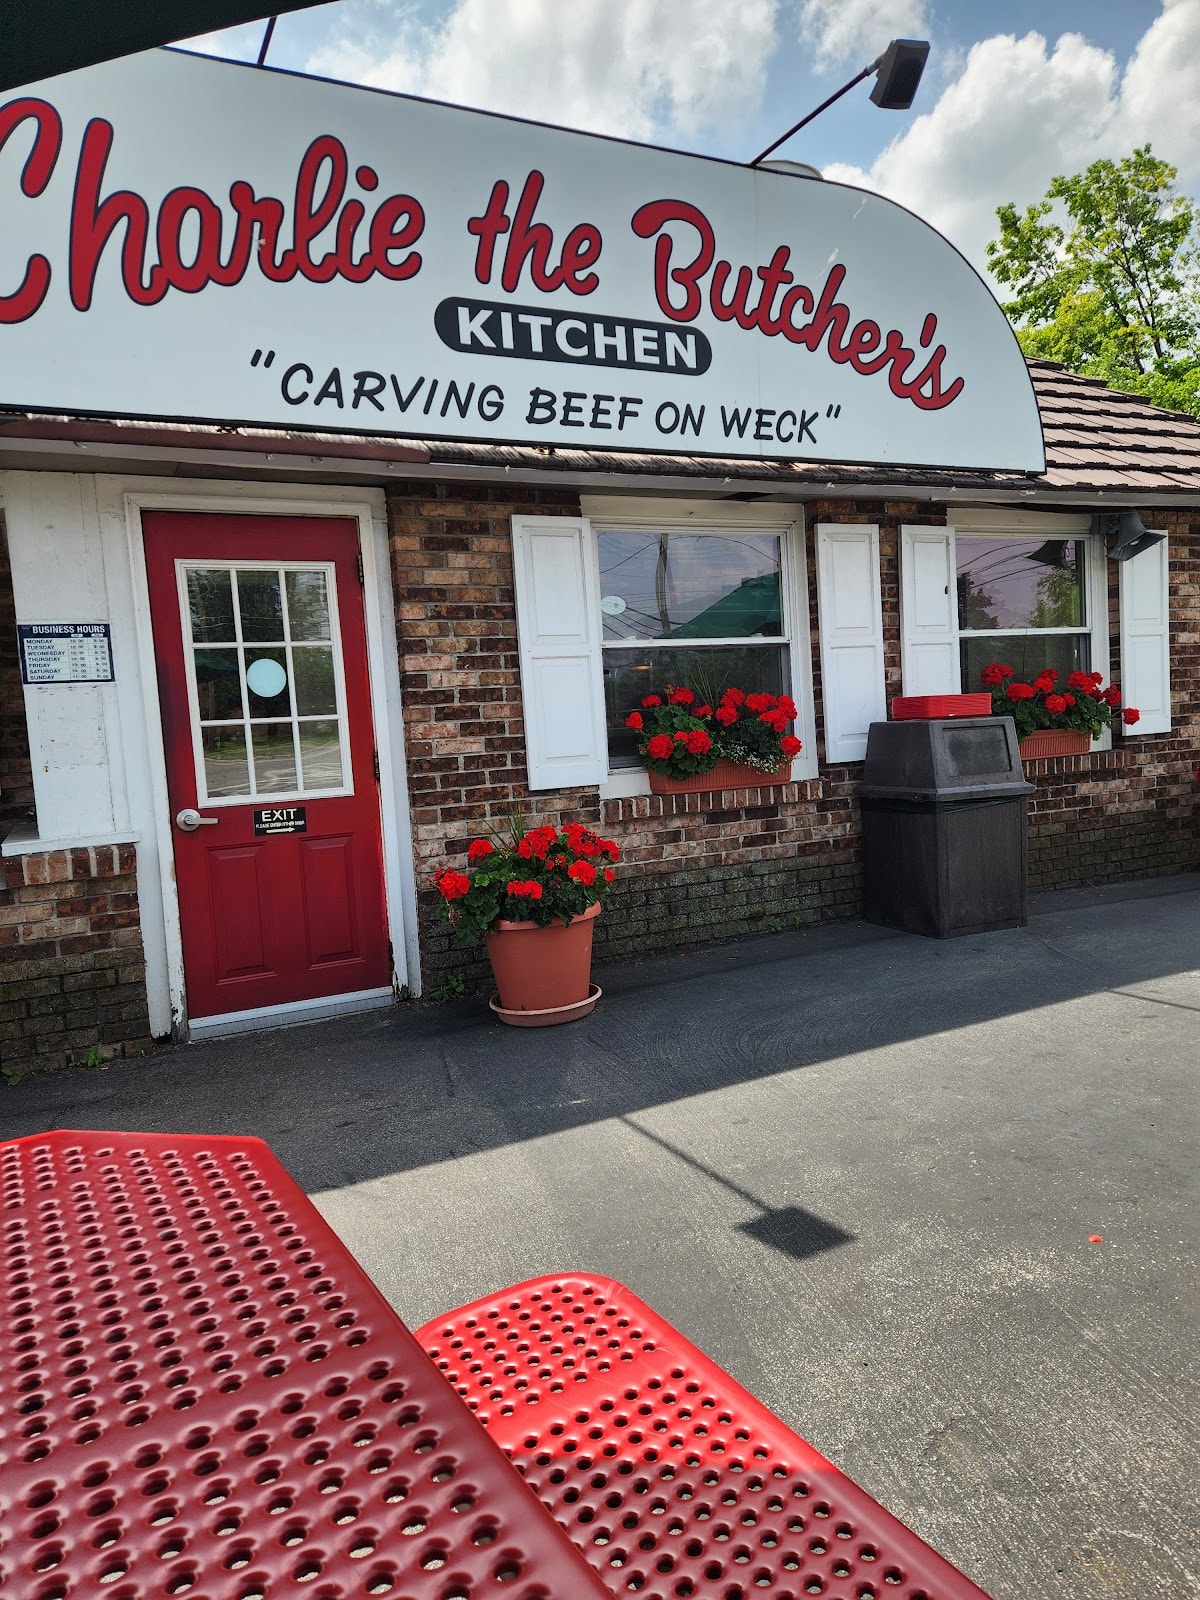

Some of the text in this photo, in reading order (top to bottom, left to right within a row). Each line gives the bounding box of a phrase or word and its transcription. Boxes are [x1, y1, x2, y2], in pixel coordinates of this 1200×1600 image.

[0, 97, 965, 411] Charlie the Butcher's
[457, 306, 697, 370] KITCHEN
[526, 387, 644, 432] BEEF
[655, 401, 707, 437] ON
[32, 625, 106, 634] BUSINESS HOURS
[261, 808, 297, 822] EXIT
